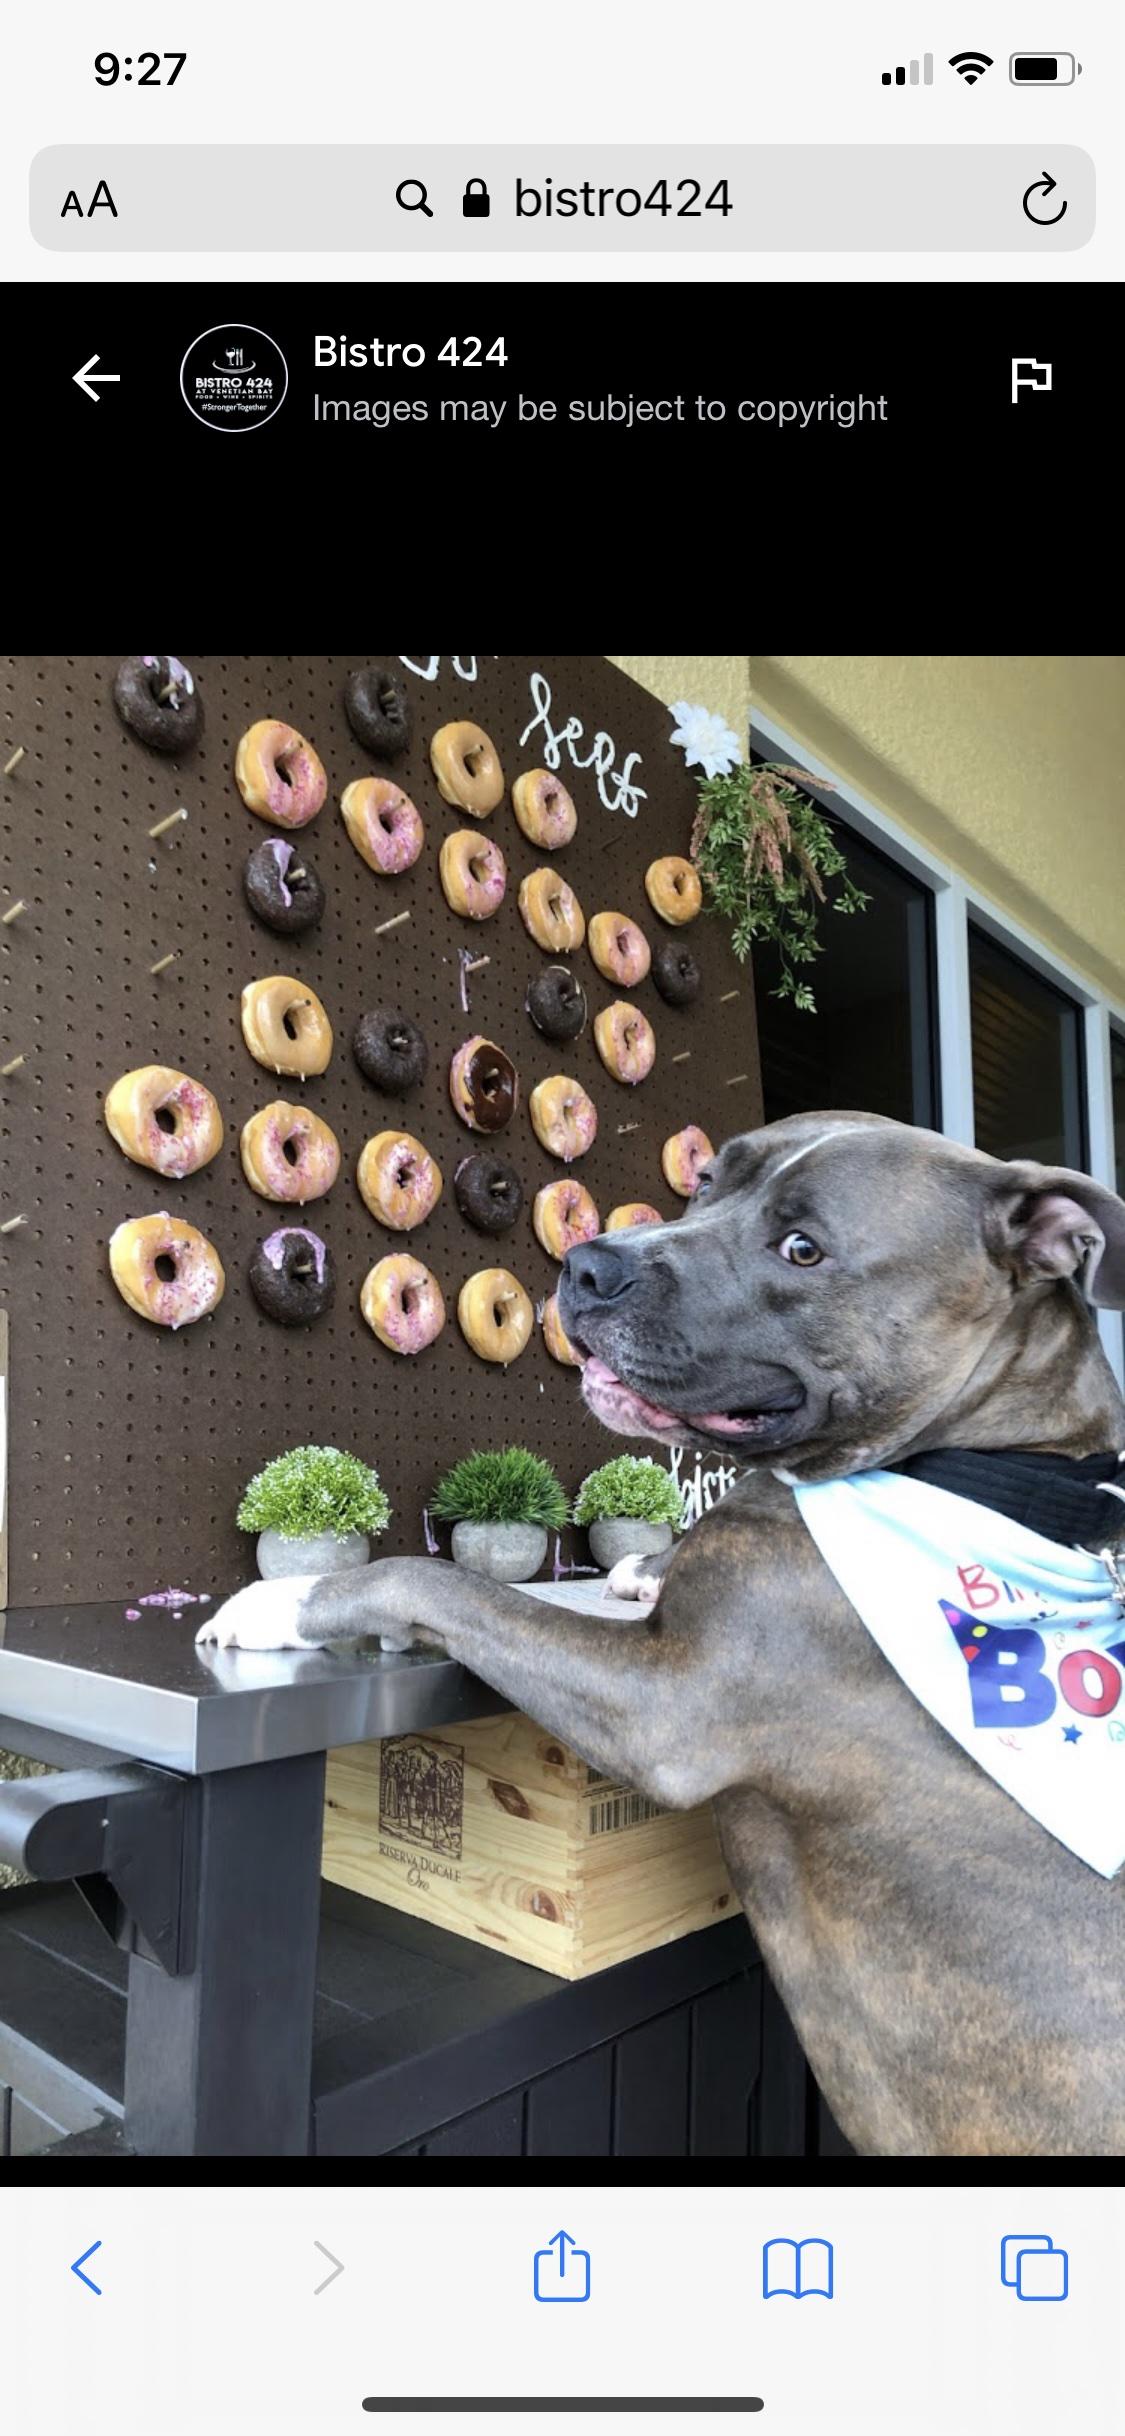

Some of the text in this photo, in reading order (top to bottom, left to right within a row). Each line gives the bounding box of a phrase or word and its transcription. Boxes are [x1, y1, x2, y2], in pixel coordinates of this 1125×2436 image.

[94, 52, 187, 87] 9:27
[516, 177, 734, 217] bistro424
[314, 334, 509, 368] Bistro 424
[195, 377, 273, 389] BISTRO 424
[201, 402, 268, 413] #StrongerTogether
[314, 393, 888, 429] Images may be subject to copyright
[378, 1841, 462, 1884] RISERVA DUCALE
